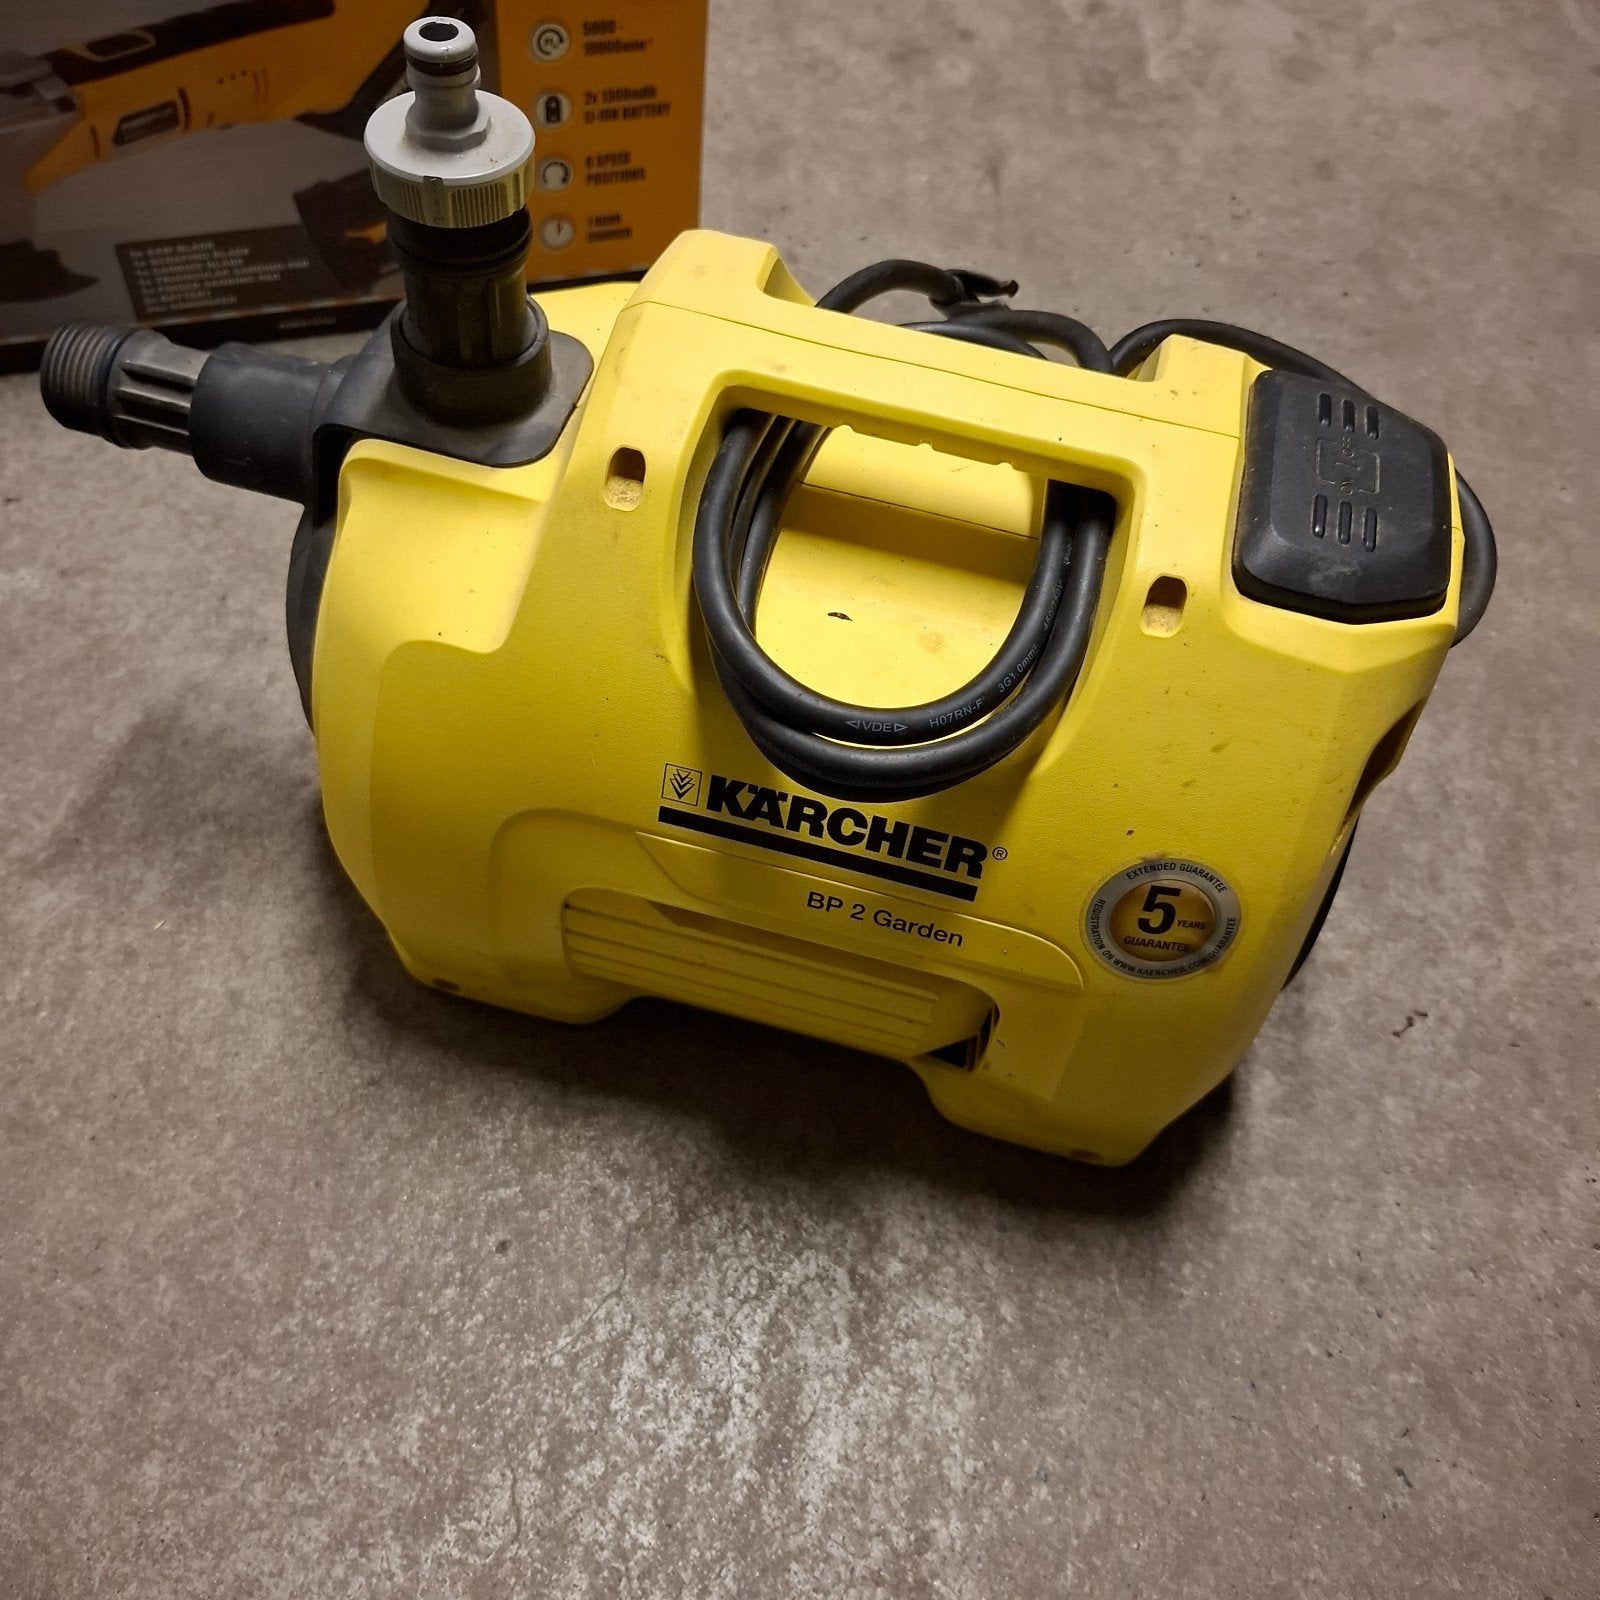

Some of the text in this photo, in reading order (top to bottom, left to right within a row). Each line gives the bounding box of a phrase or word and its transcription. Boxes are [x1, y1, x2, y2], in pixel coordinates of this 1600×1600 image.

[928, 698, 985, 729] H07RN-F
[1126, 862, 1227, 894] EXTENDED GUARANTEE
[807, 891, 964, 947] BP 2 Garden
[1090, 898, 1107, 951] REGISTRATION
[1101, 949, 1114, 961] ON
[1137, 885, 1207, 935] 5 YEARS
[1124, 935, 1194, 953] GUARANTEE
